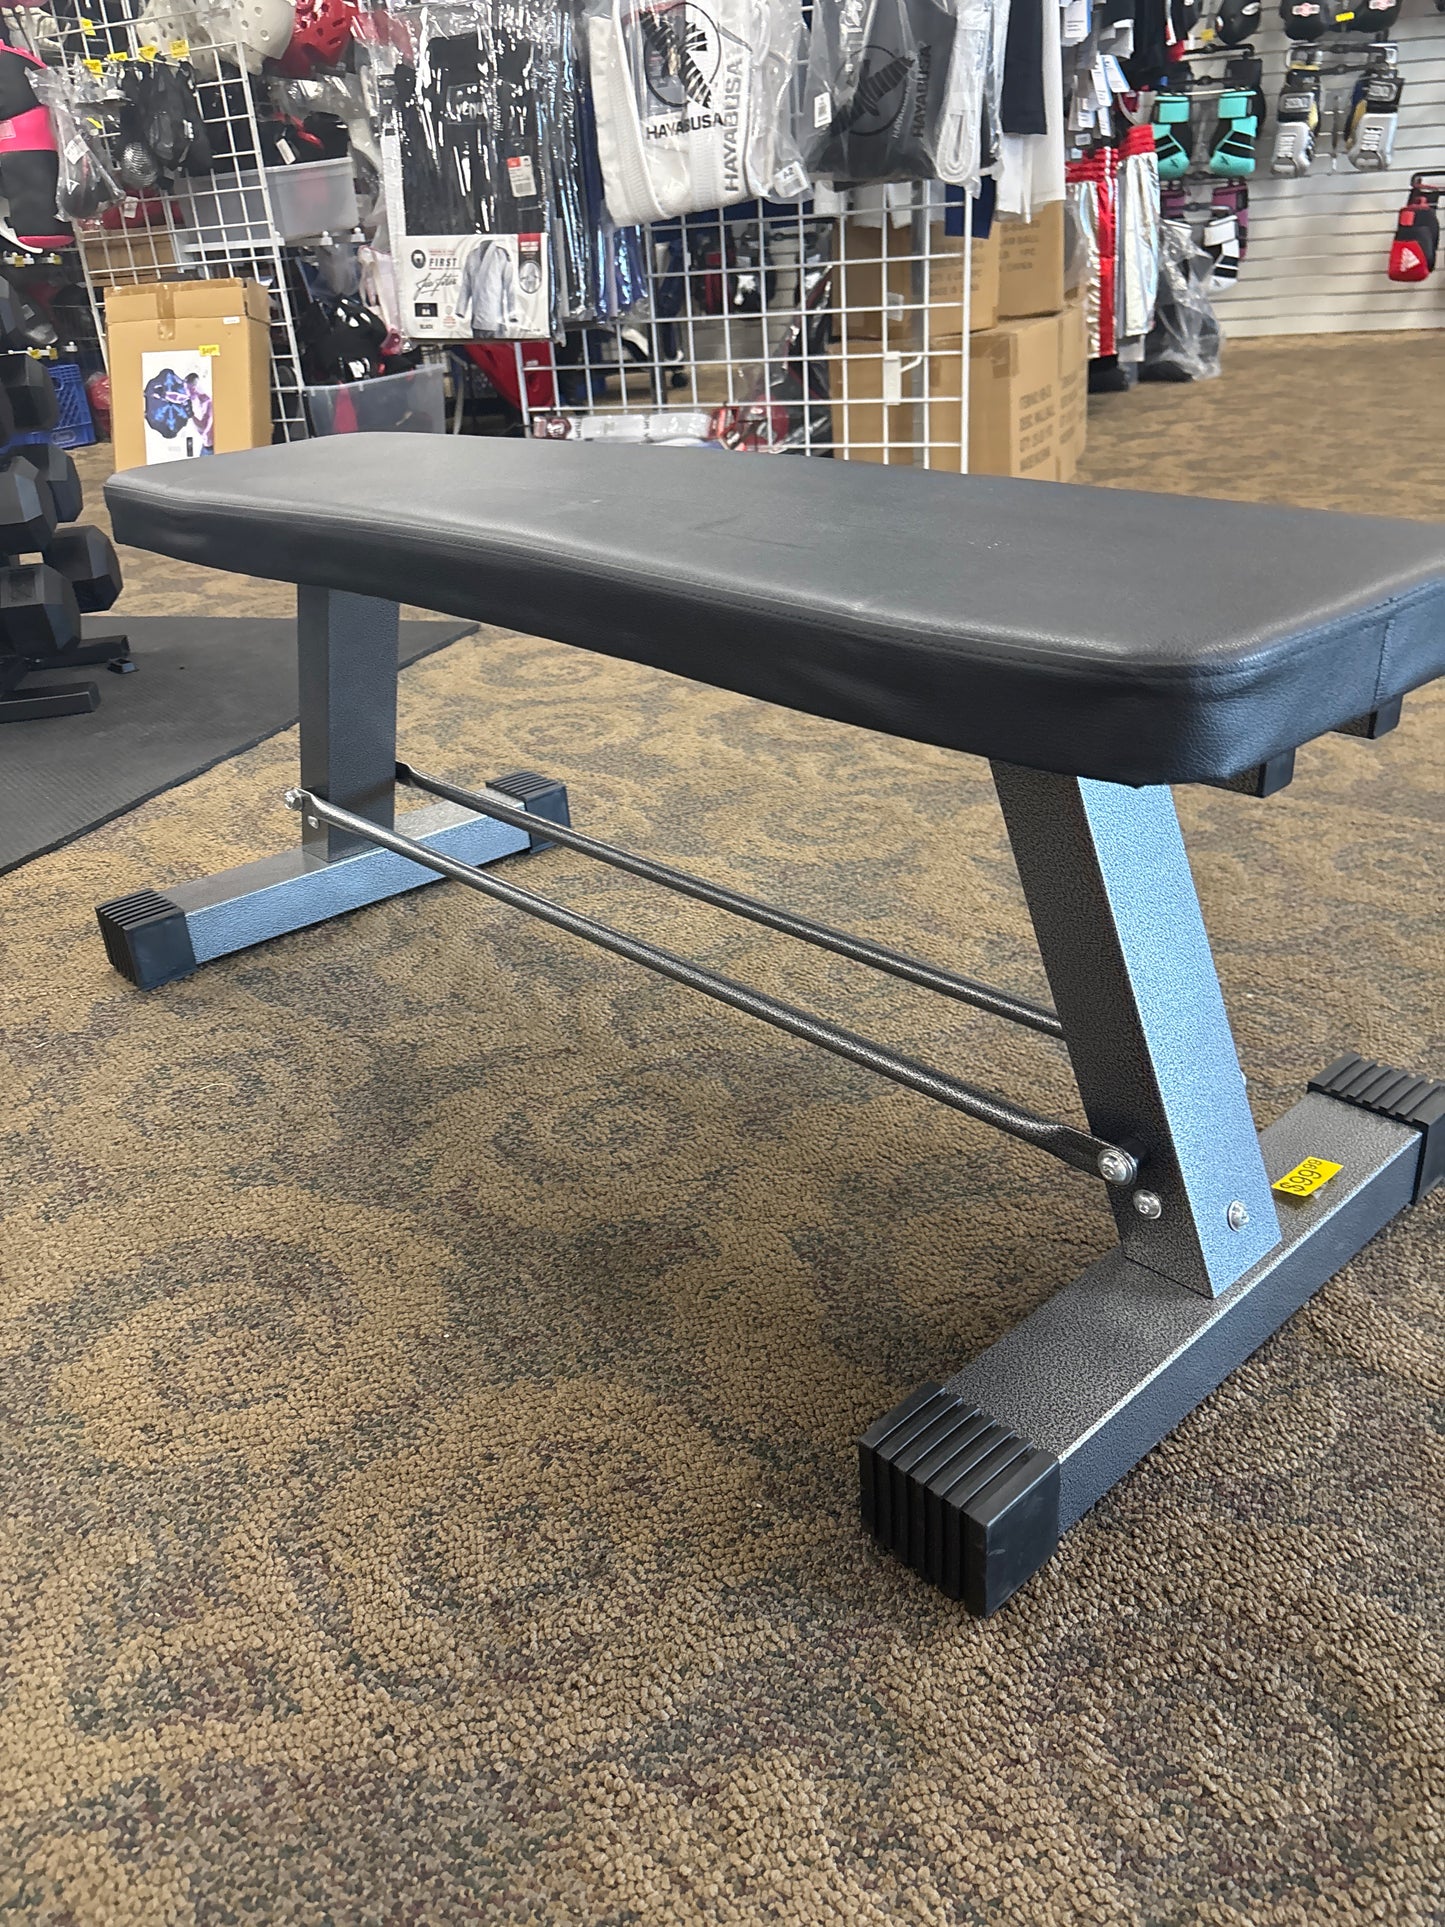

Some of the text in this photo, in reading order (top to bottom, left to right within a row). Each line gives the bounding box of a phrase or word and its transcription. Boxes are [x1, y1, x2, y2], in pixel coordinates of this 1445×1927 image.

[724, 56, 743, 192] HAYABUSA
[783, 167, 795, 179] A2
[429, 257, 458, 267] FIRST
